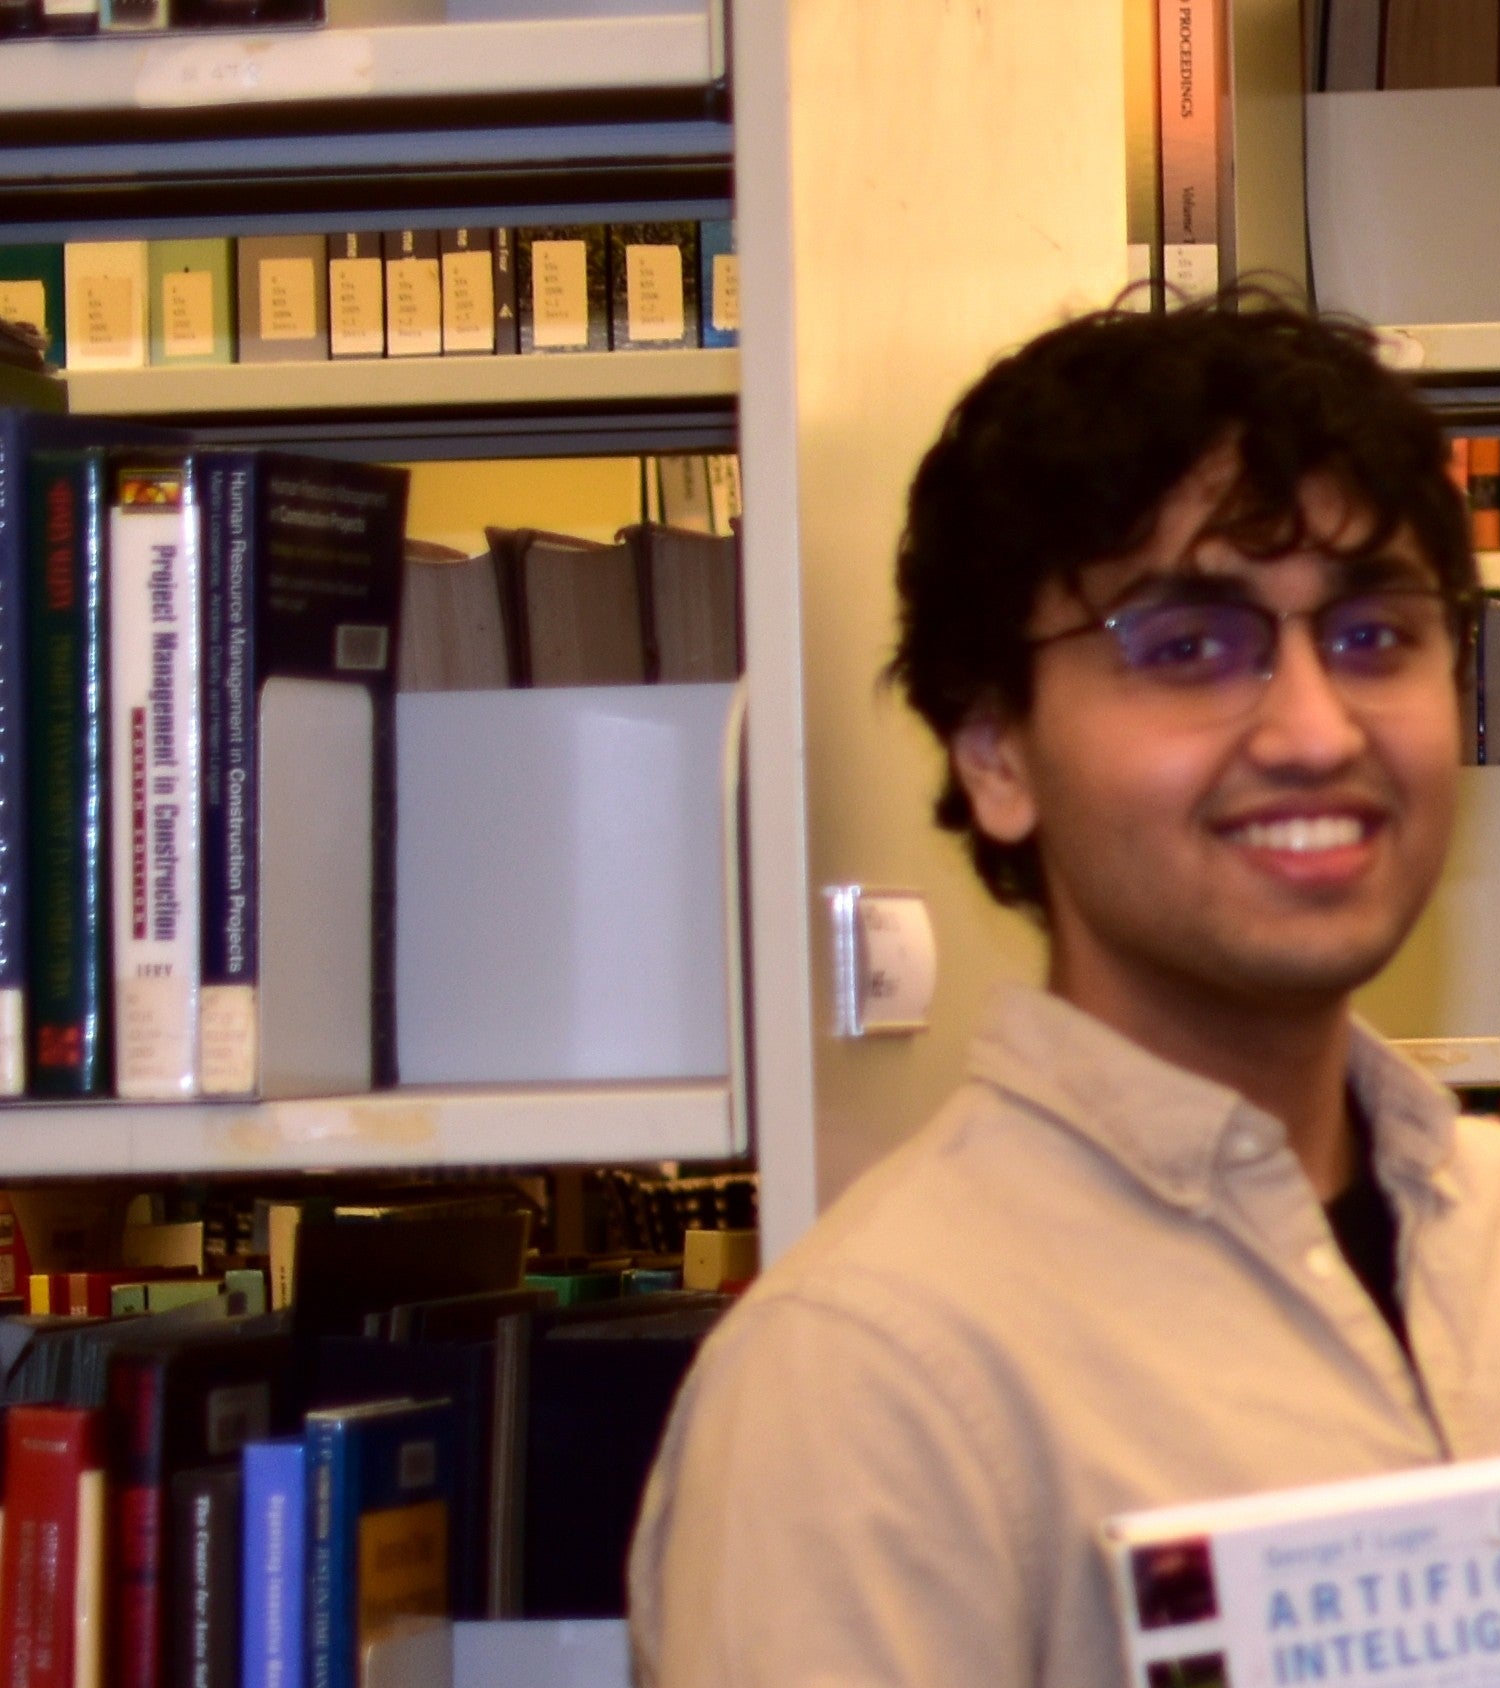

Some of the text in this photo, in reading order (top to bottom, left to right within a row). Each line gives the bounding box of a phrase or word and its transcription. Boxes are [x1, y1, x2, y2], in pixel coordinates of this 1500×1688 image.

[1180, 8, 1194, 118] PROCEEDINGS
[147, 545, 180, 942] Project Management in Construction
[223, 471, 246, 972] Human Resource Management in Construction Projects
[194, 1496, 212, 1527] The
